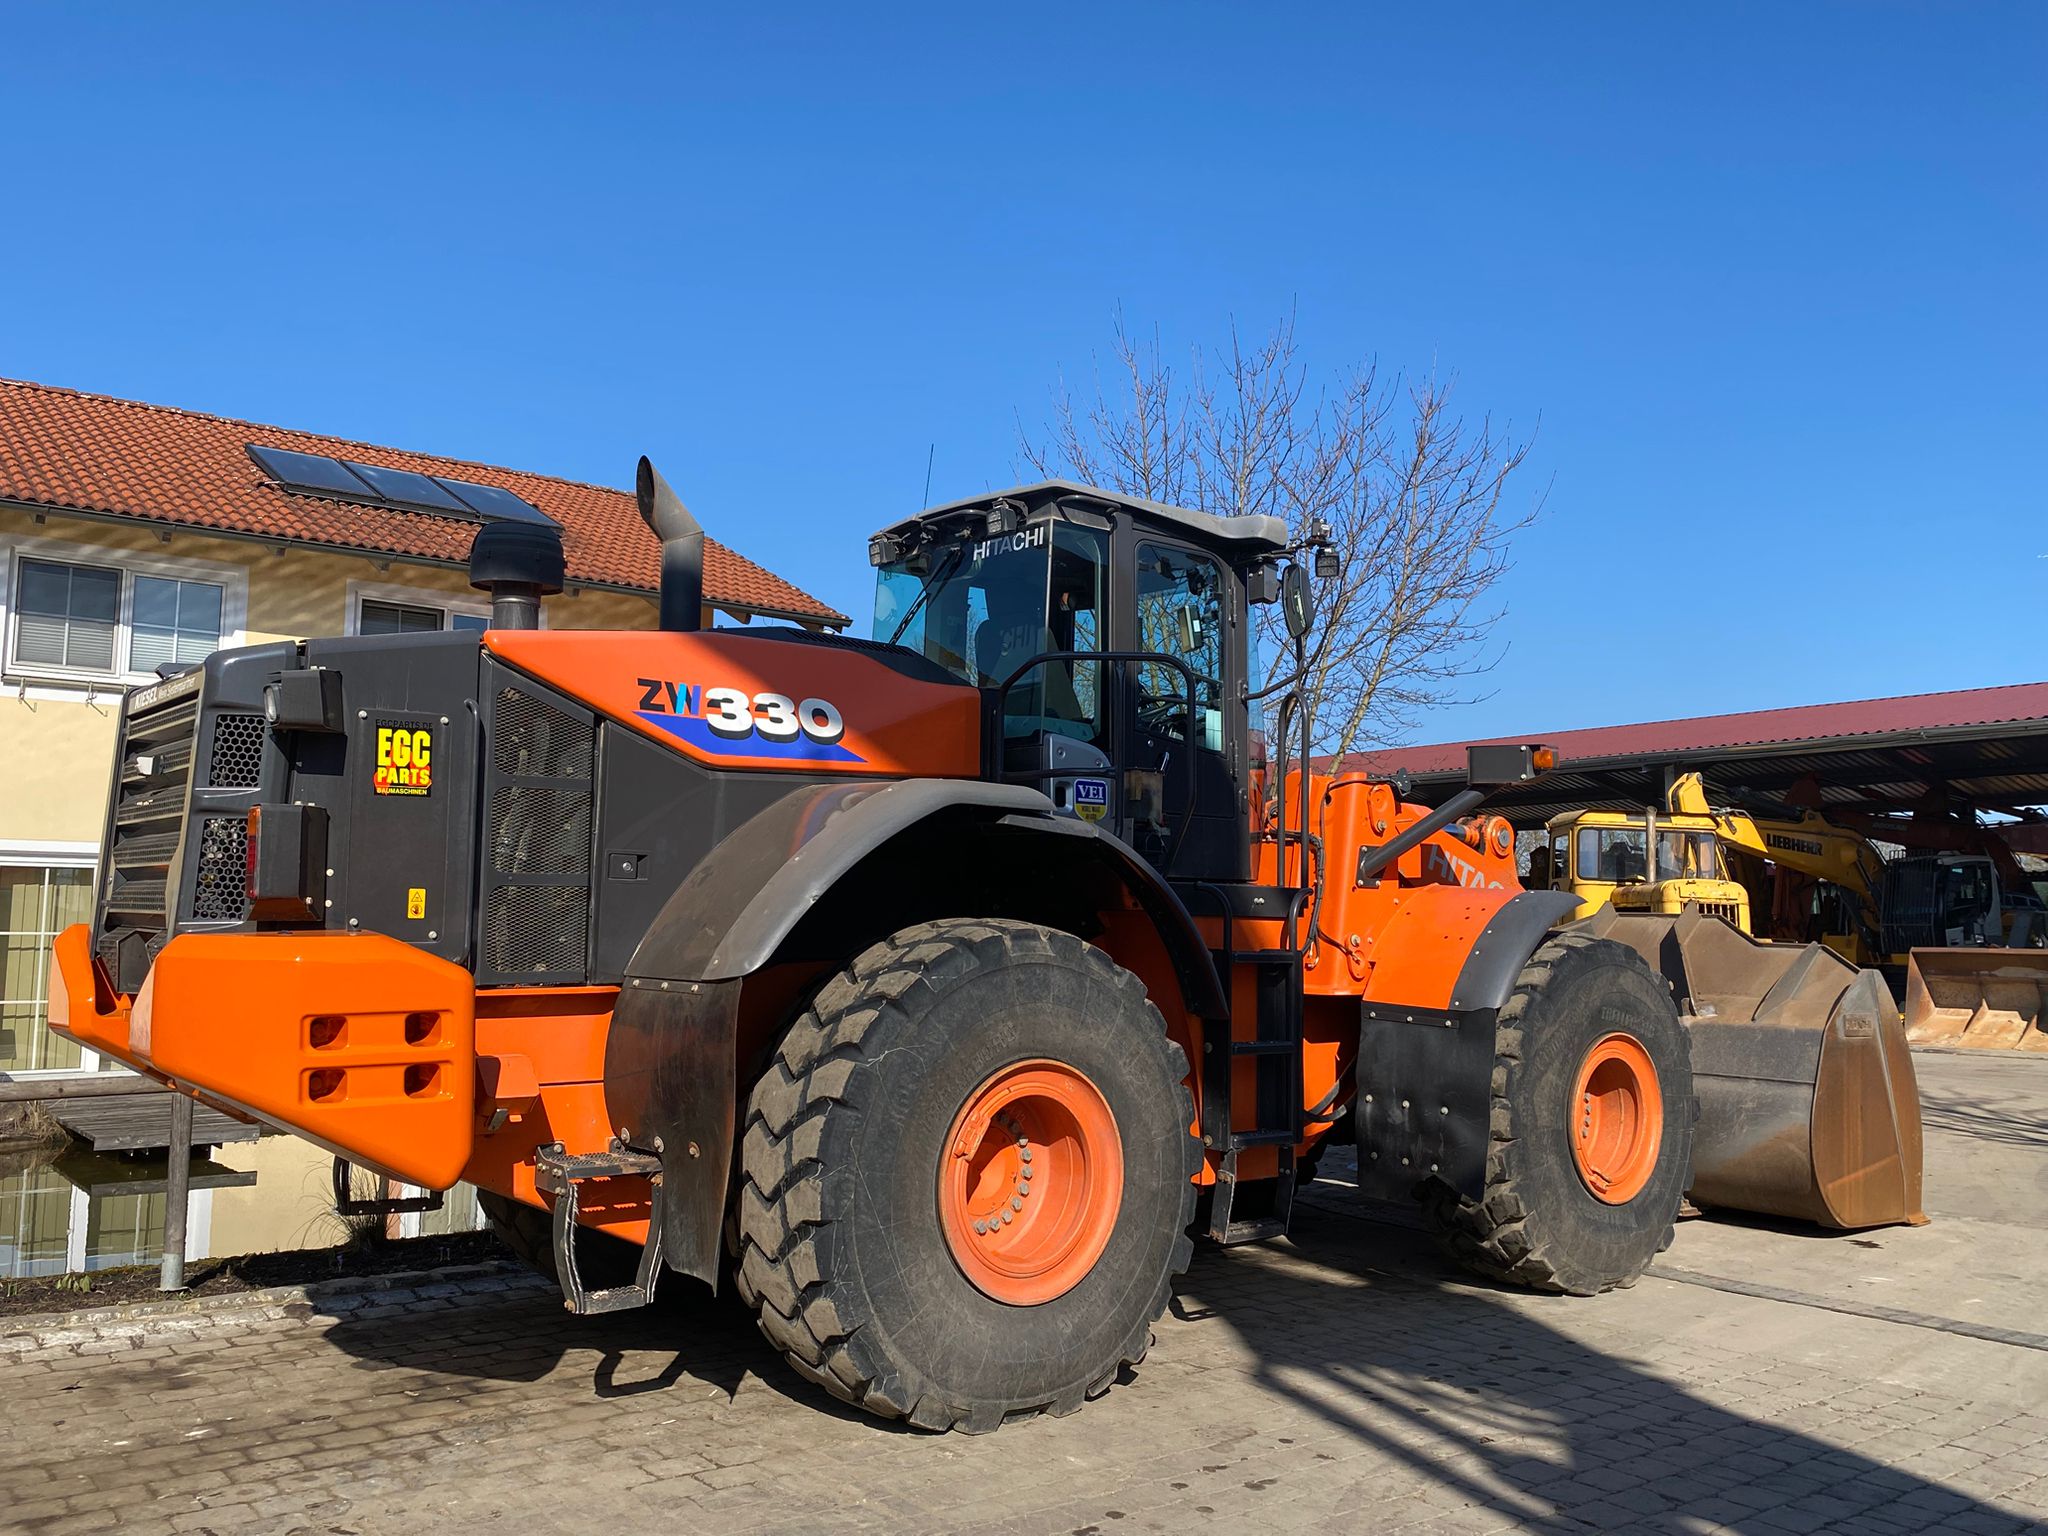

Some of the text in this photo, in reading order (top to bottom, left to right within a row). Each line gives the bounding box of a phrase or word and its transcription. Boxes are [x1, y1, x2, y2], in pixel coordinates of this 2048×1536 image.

[973, 527, 1044, 561] HITACHI
[377, 728, 431, 768] EGC
[377, 767, 431, 785] PARTS
[376, 787, 428, 796] BAUMASCHINEN
[1078, 785, 1104, 799] VEI
[1766, 833, 1824, 857] LIEBHERR
